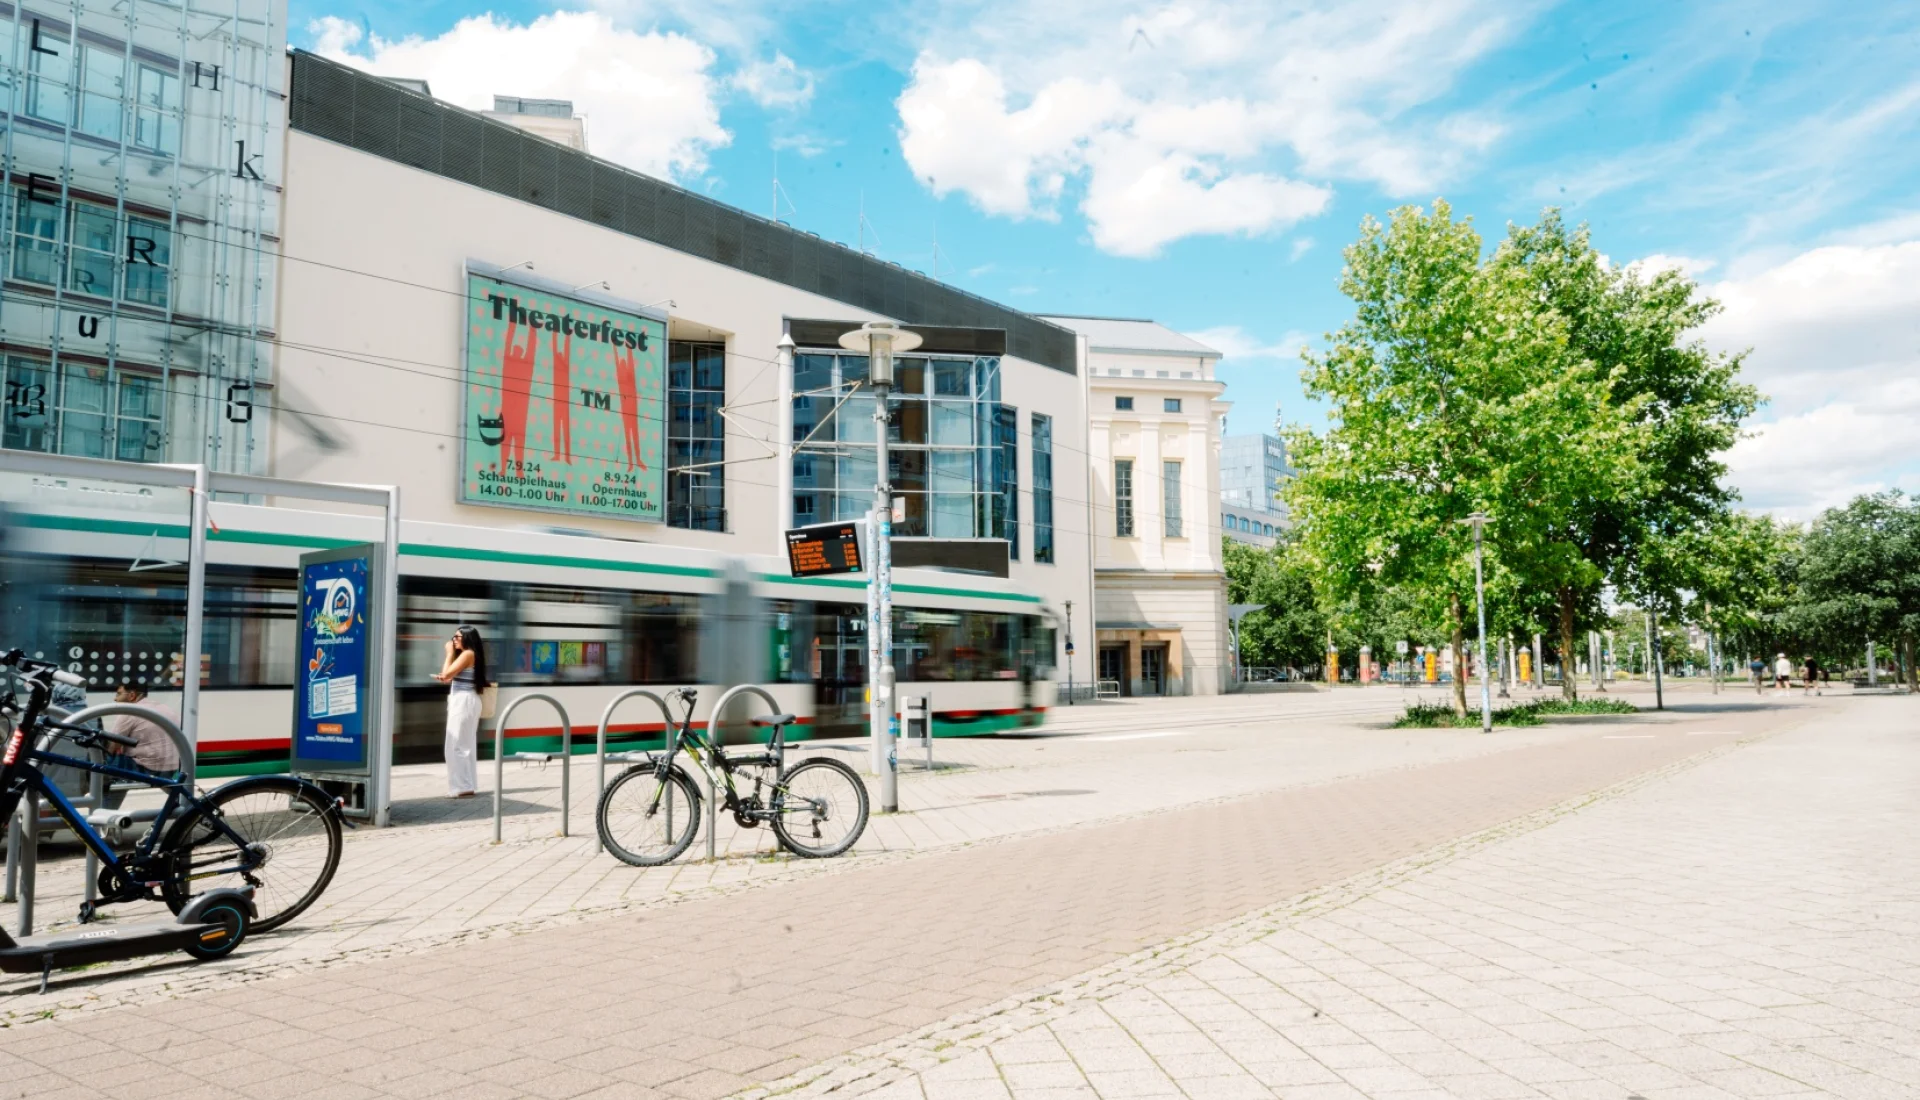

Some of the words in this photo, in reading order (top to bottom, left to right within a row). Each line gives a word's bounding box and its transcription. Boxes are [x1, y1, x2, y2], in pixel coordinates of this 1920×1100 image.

[31, 18, 58, 56] L
[190, 60, 223, 92] H
[28, 172, 56, 206] E
[125, 235, 158, 267] R
[488, 293, 649, 352] Theaterfest
[581, 389, 611, 411] TM
[506, 459, 541, 473] 7.9.24
[478, 469, 567, 489] Schauspielhaus
[604, 472, 637, 485] 8.9.24
[545, 490, 565, 502] Uhr
[592, 483, 648, 499] Opernhaus
[640, 501, 658, 512] Uhr
